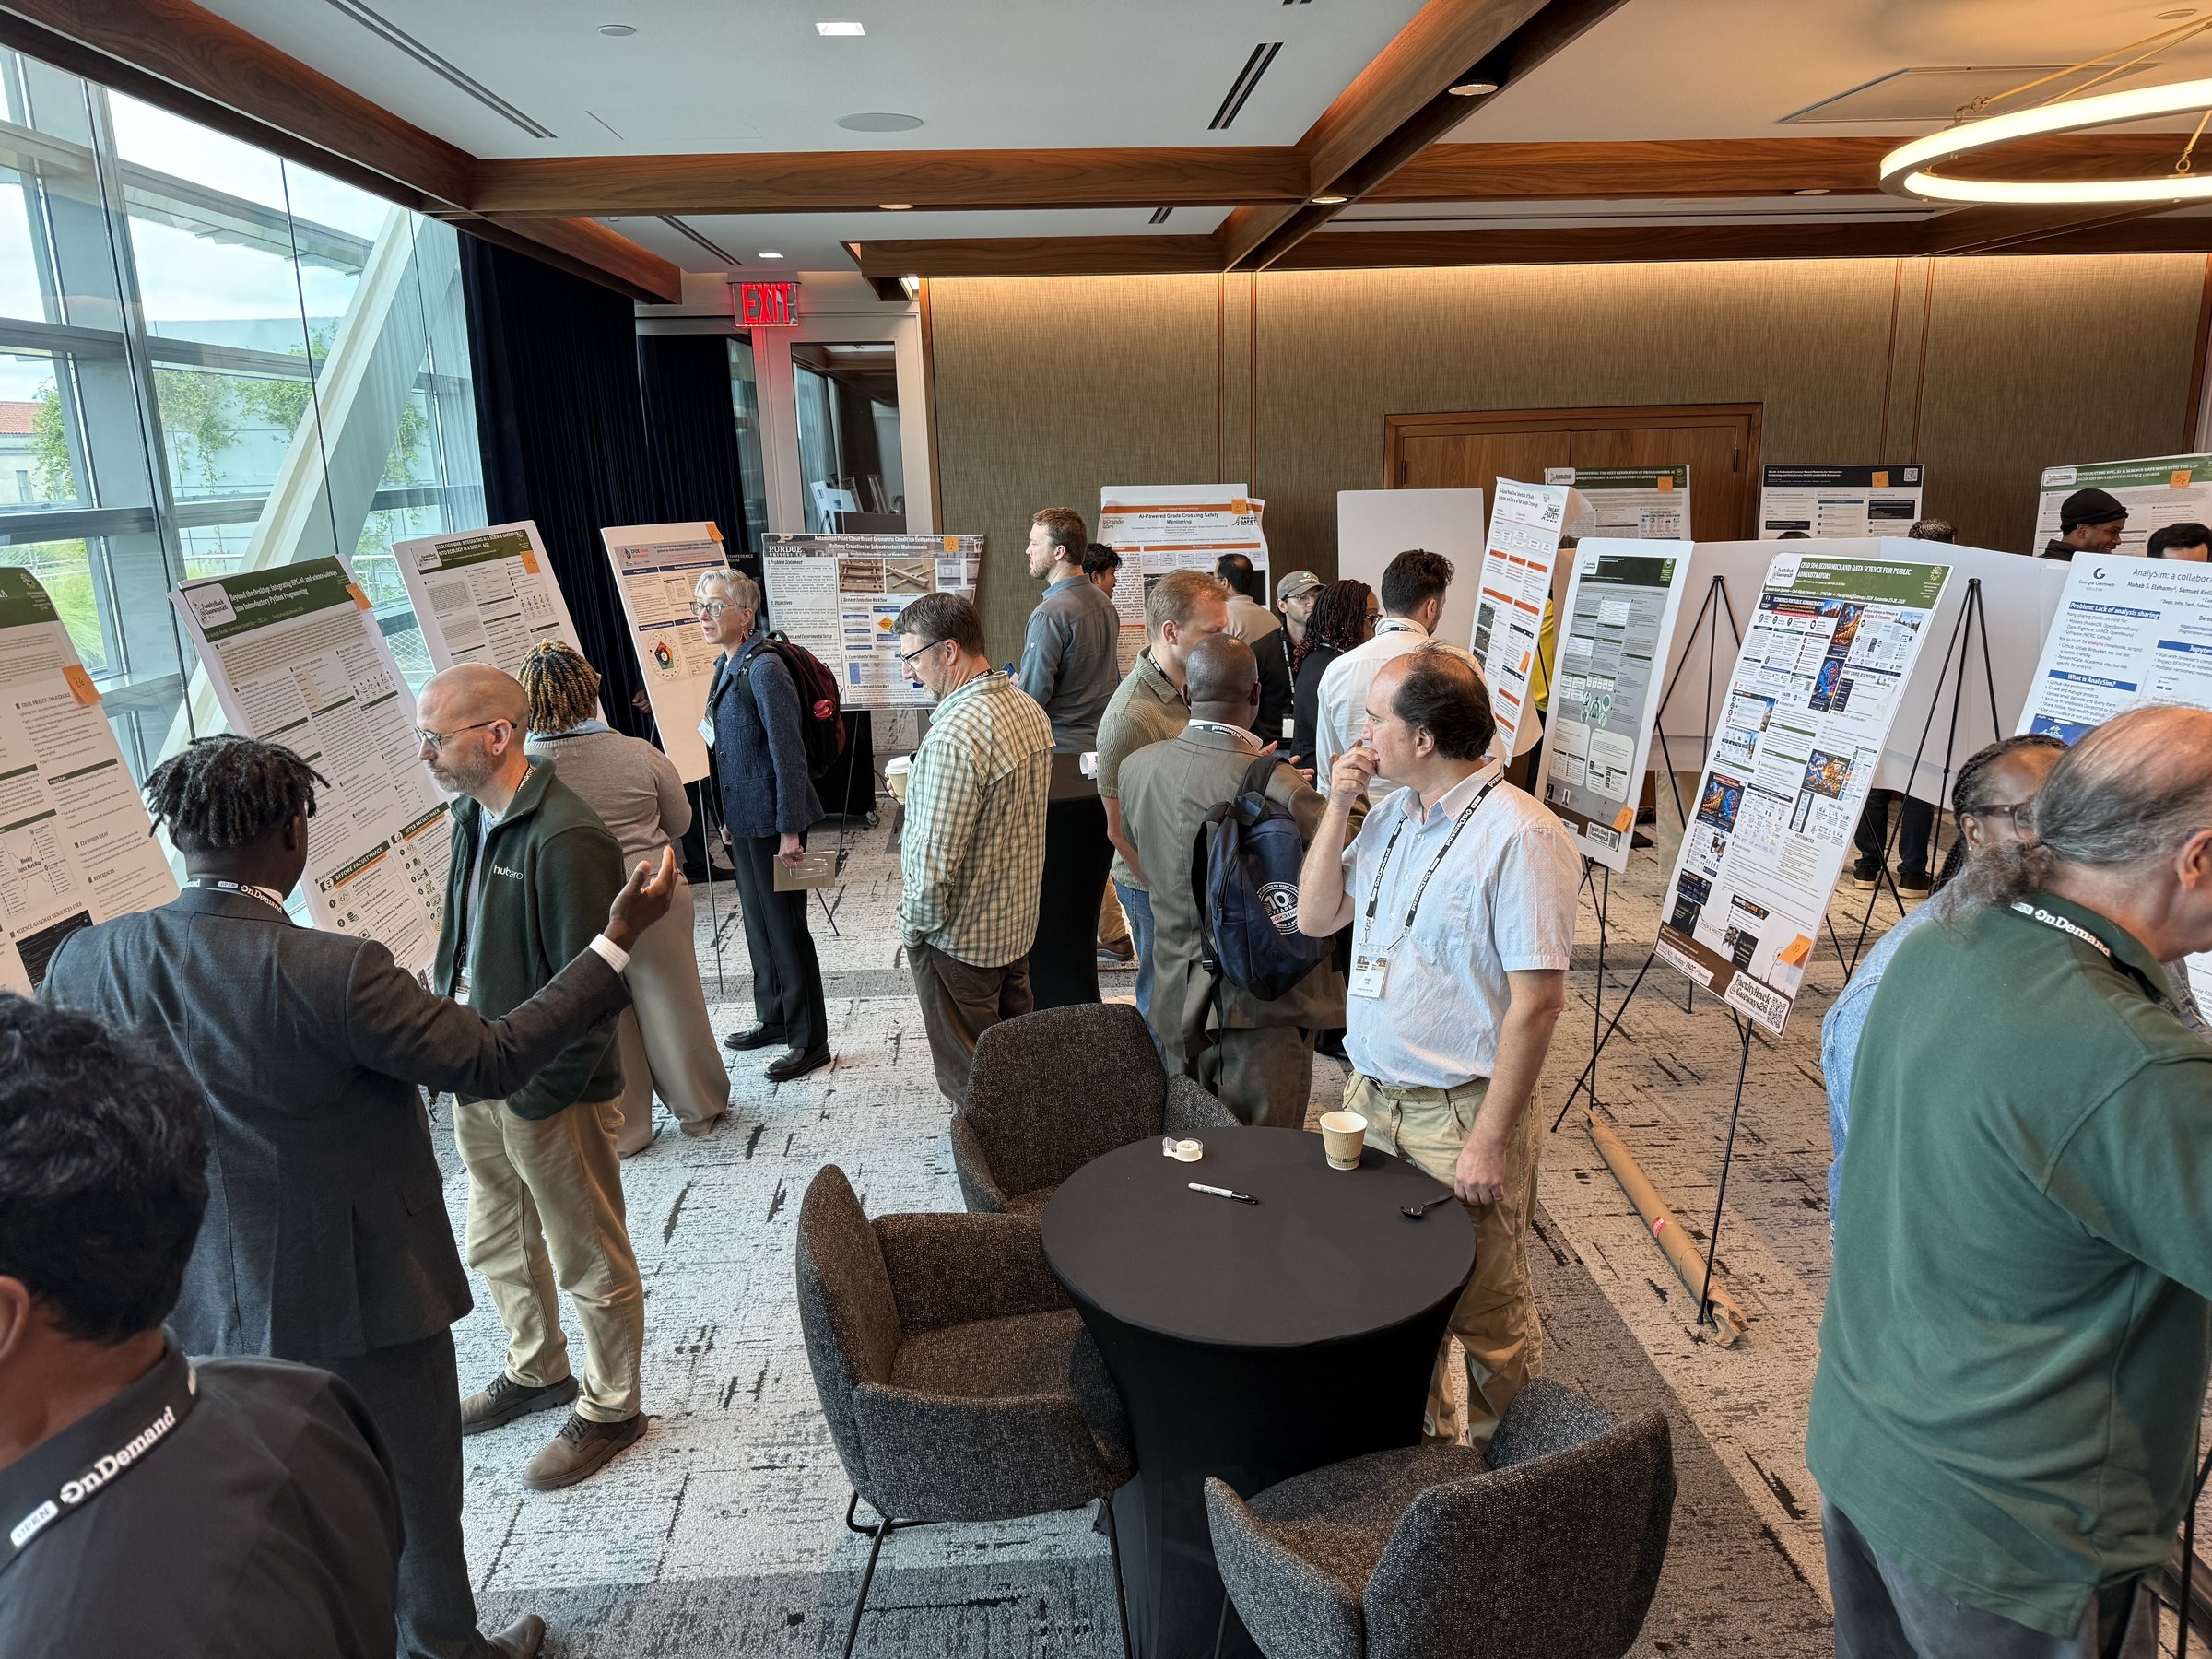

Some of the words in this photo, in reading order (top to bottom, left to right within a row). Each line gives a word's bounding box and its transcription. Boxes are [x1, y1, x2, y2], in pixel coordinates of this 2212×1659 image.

[741, 284, 791, 323] EXIT
[1864, 565, 1882, 573] SCIENCE
[1892, 567, 1912, 575] PUBLIC
[2133, 569, 2170, 579] AnalySim:
[229, 592, 246, 603] Beyond
[245, 589, 253, 597] the
[252, 584, 271, 596] Desktop:
[270, 580, 292, 592] Integrating
[312, 572, 324, 581] Science
[323, 570, 337, 579] Gateways
[201, 599, 224, 609] FacultyHack
[242, 597, 270, 611] Introductory
[268, 594, 285, 604] Python
[283, 587, 309, 601] Programming
[2070, 602, 2094, 610] Problem:
[2138, 611, 2159, 619] sharing
[74, 677, 85, 688] 26
[2088, 677, 2116, 687] AnalySim?
[32, 698, 47, 706] PROJECT
[49, 692, 70, 702] DELIVERABLE
[405, 824, 415, 834] AFTER
[417, 808, 441, 827] FACULTYHACK
[1445, 809, 1473, 847] OnDemand
[80, 835, 98, 846] EXPANSION
[99, 831, 108, 840] IDEAS
[20, 855, 33, 865] Weekly
[335, 867, 351, 880] BEFORE
[353, 848, 383, 870] FACULTYHACK
[1374, 847, 1392, 887] OnDemand
[94, 869, 115, 881] REFERENCES
[241, 885, 282, 914] OnDemand
[1265, 892, 1289, 910] 10
[1411, 871, 1432, 912] OnDemand
[17, 923, 32, 935] SCIENCE
[34, 915, 51, 928] GATEWAY
[52, 906, 72, 920] RESOURCES
[73, 901, 82, 912] USED
[1272, 904, 1293, 914] YEARS
[2035, 909, 2111, 958] OnDemand
[1686, 962, 1696, 971] TACC
[1729, 984, 1768, 1014] @Gateways26
[1735, 975, 1771, 1003] FacultyHack
[17, 1506, 52, 1539] OPEN
[60, 1406, 176, 1504] OnDemand
